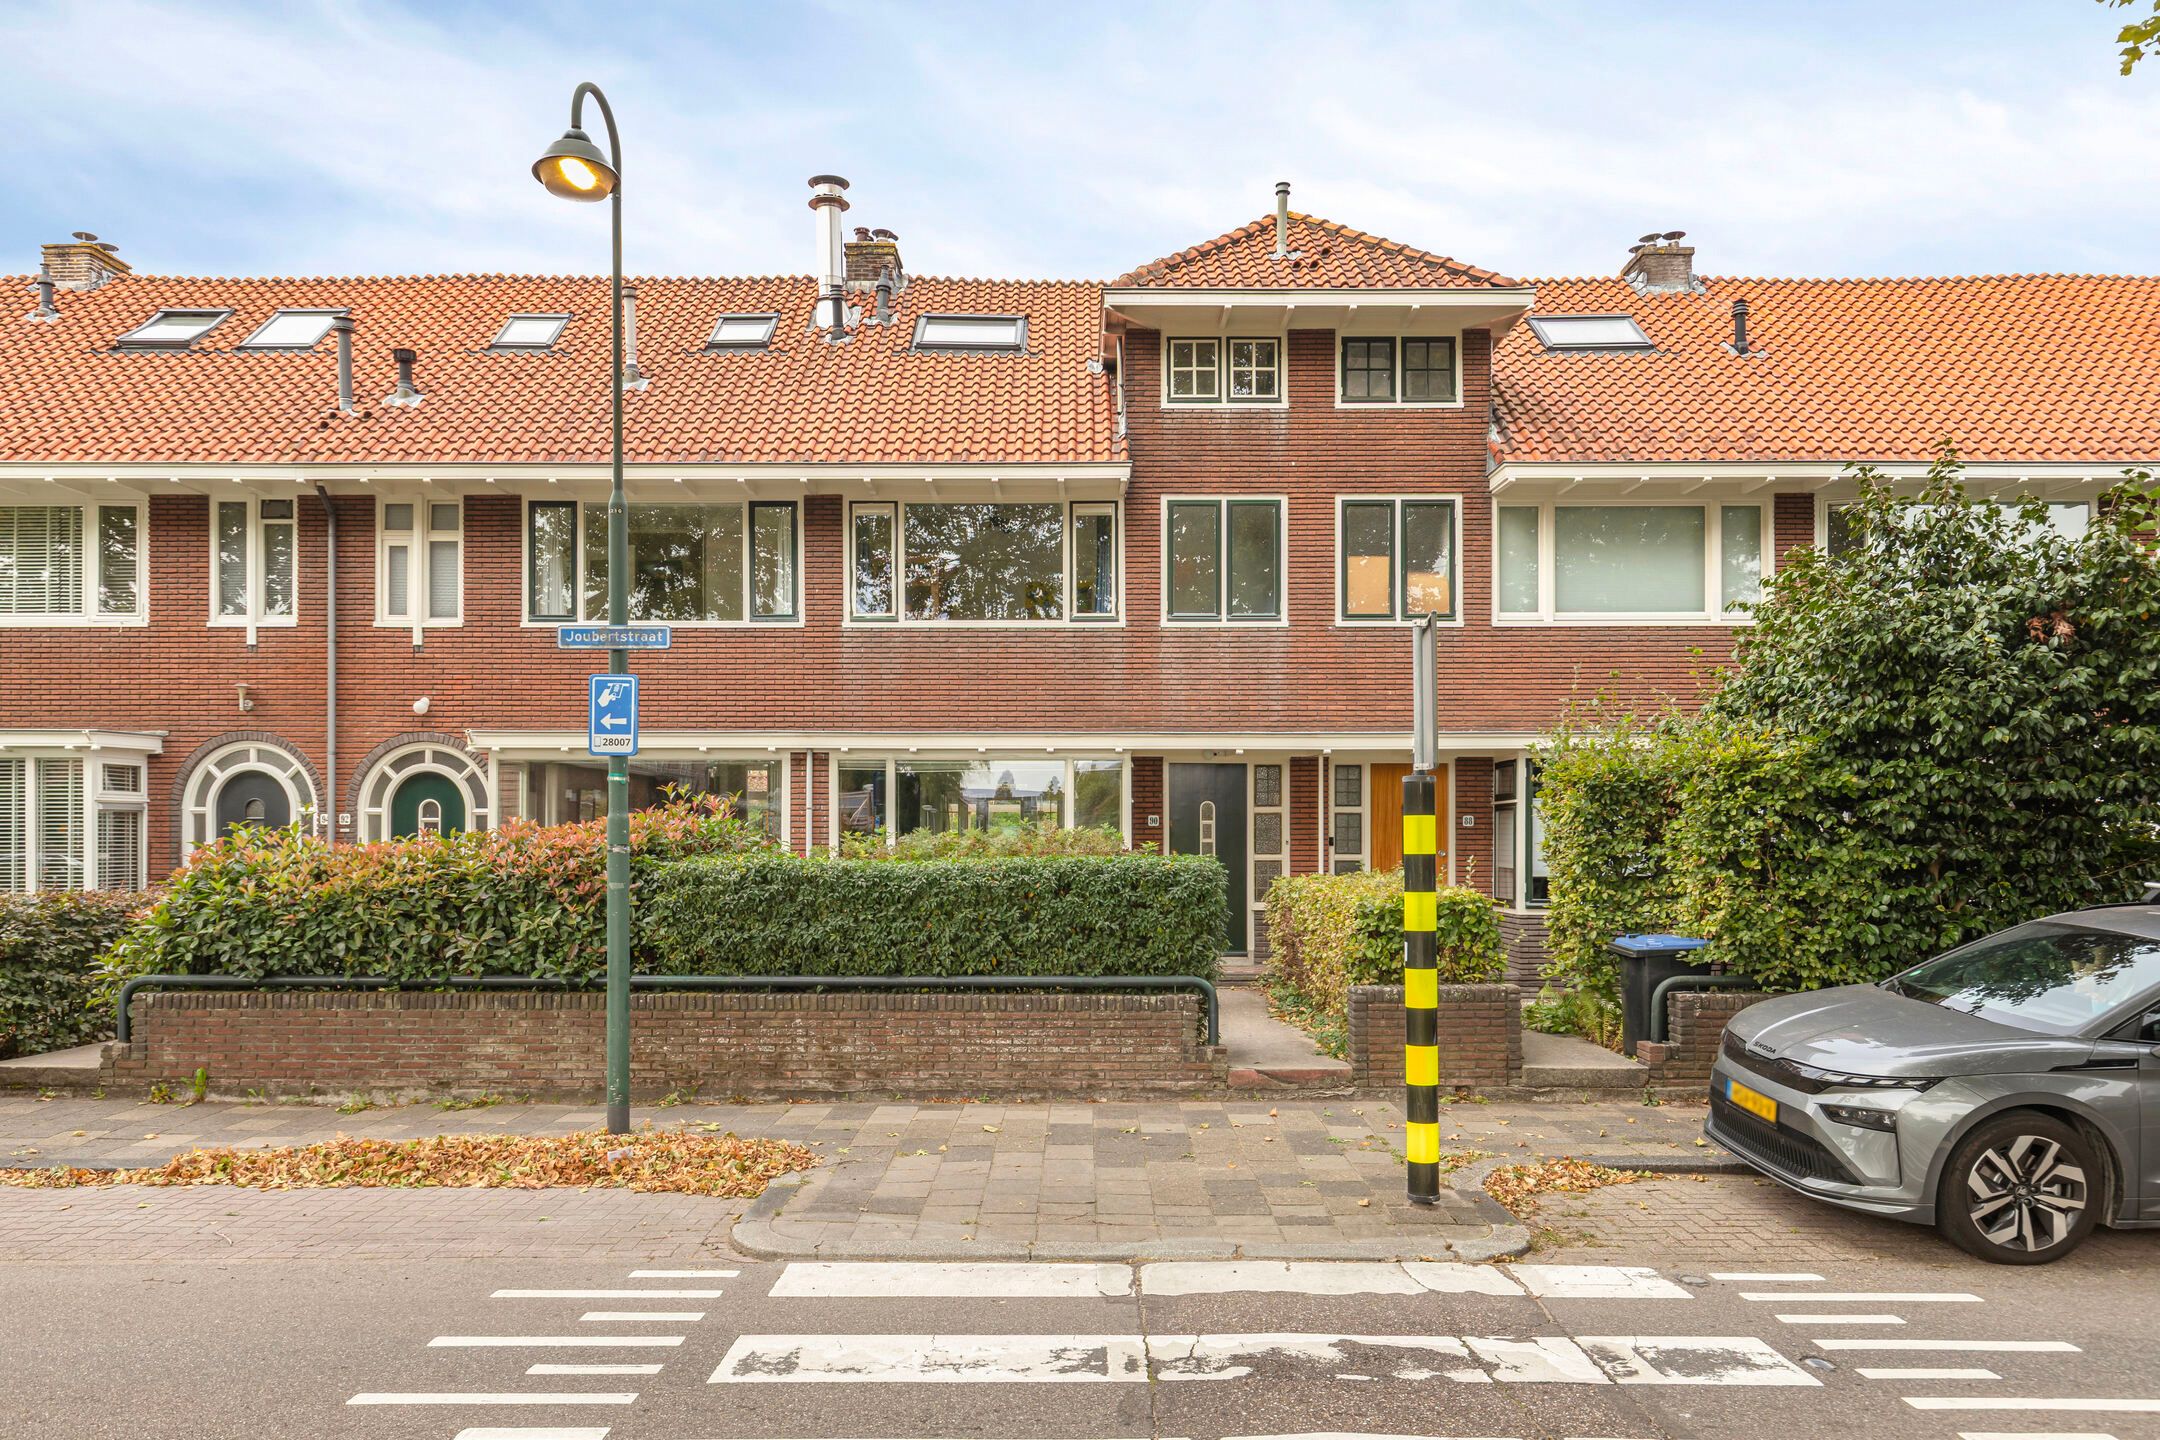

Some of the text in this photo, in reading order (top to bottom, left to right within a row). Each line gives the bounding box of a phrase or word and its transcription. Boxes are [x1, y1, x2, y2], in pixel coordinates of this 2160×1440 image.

[565, 630, 663, 642] Joubertstraat
[602, 737, 631, 747] 28007
[340, 815, 349, 824] 92
[1149, 816, 1158, 825] 90
[1463, 816, 1473, 826] 88
